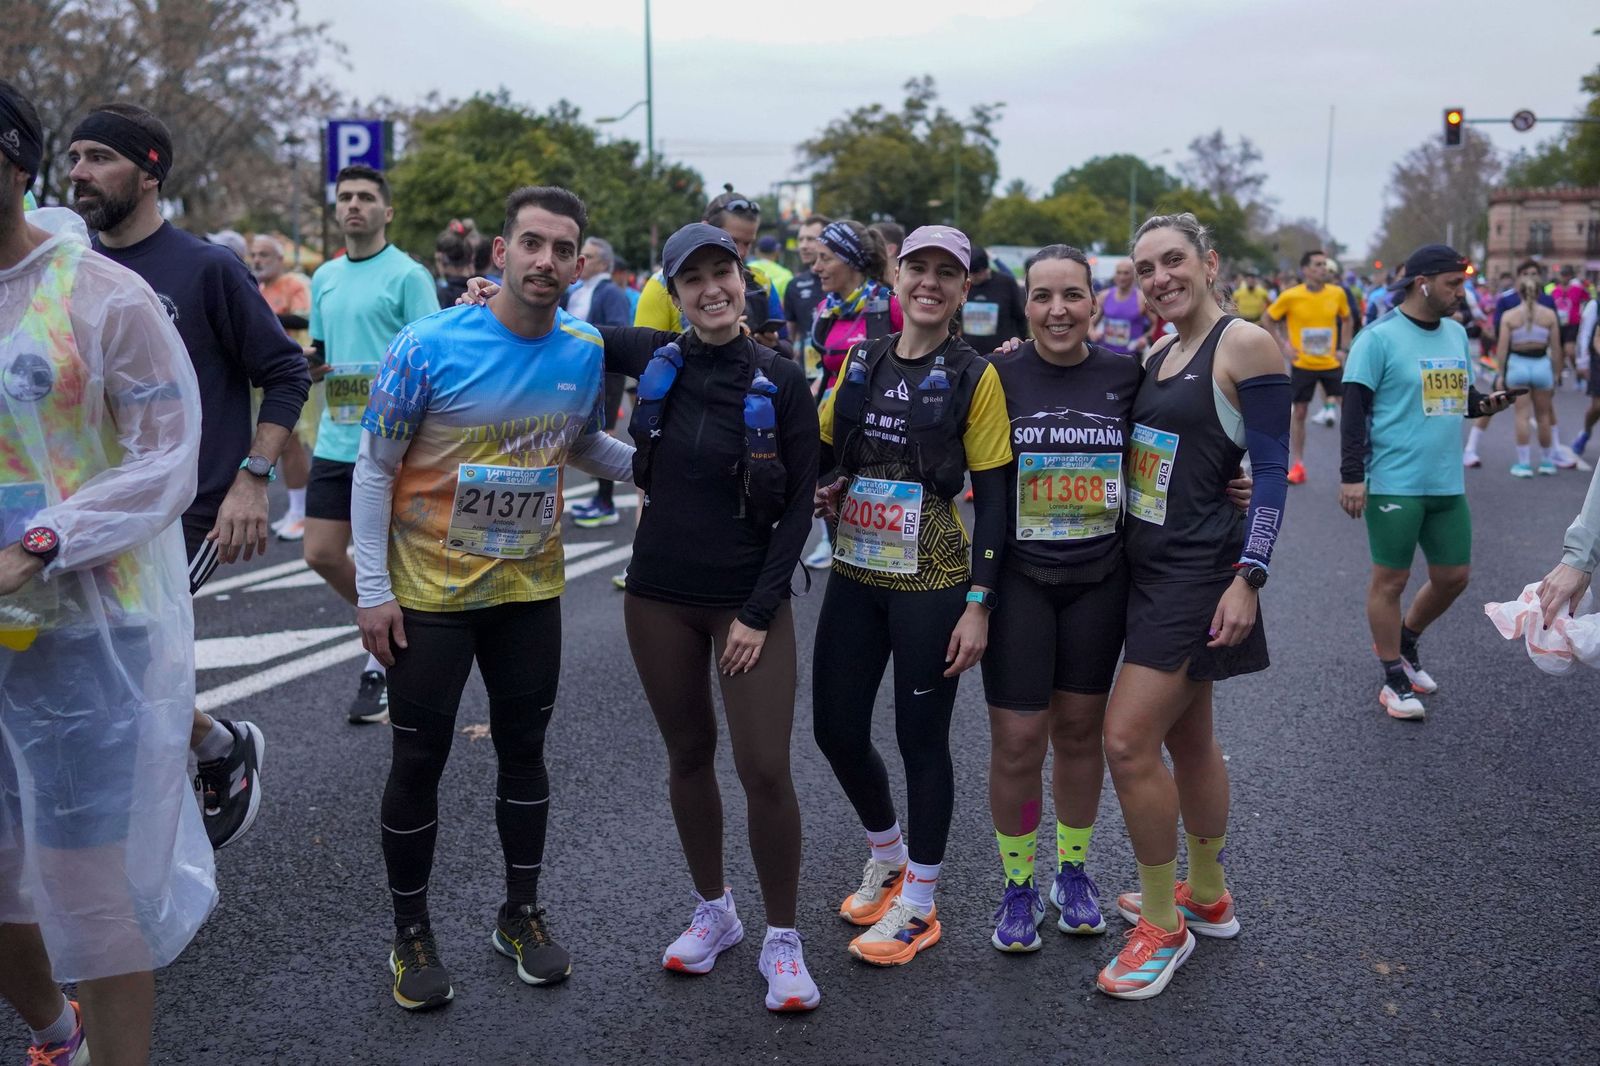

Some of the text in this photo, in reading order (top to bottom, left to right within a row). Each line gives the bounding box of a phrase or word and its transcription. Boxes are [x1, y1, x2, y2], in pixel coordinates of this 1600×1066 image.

[338, 124, 371, 170] P
[329, 378, 369, 397] 12946
[557, 383, 577, 391] HOKA
[1427, 373, 1464, 389] 15136
[879, 415, 893, 428] NO
[1014, 425, 1124, 447] SOY MONTAÑA
[1027, 475, 1105, 502] 11368
[462, 488, 545, 519] 21377
[842, 496, 904, 531] 22032
